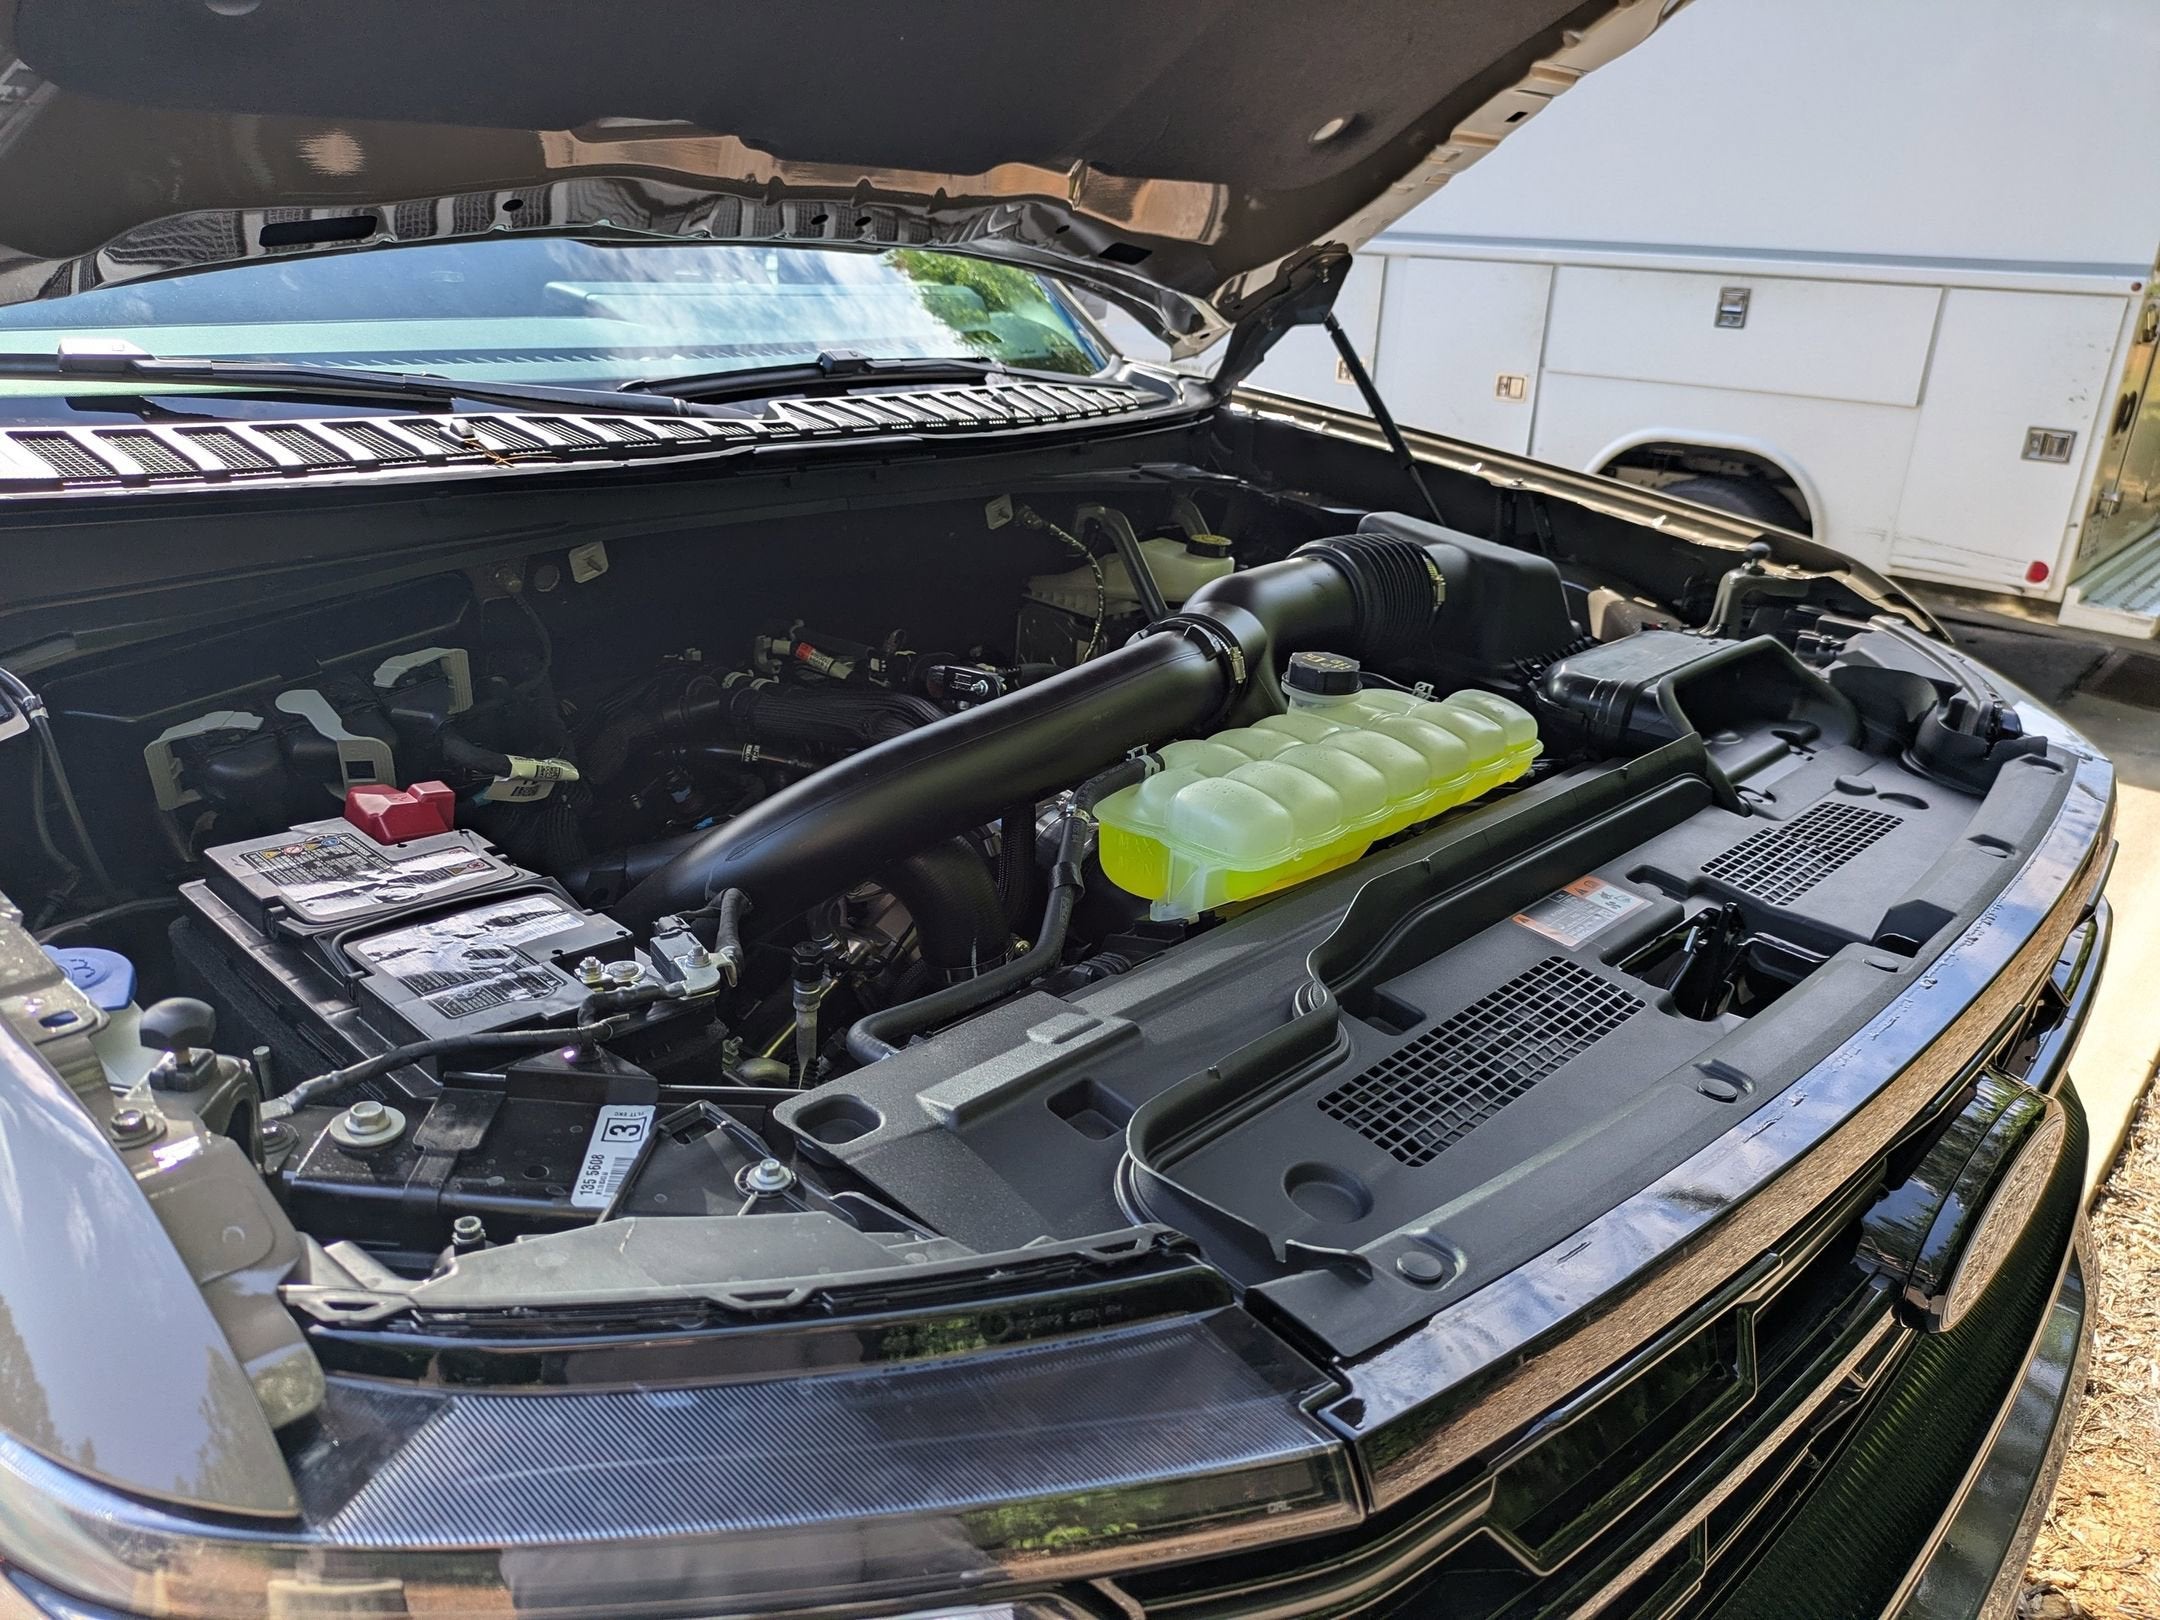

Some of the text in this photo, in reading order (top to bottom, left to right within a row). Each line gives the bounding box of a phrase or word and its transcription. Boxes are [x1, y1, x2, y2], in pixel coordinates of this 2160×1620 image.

[609, 1124, 641, 1137] 3
[586, 1153, 605, 1176] 5608
[579, 1179, 597, 1196] 135
